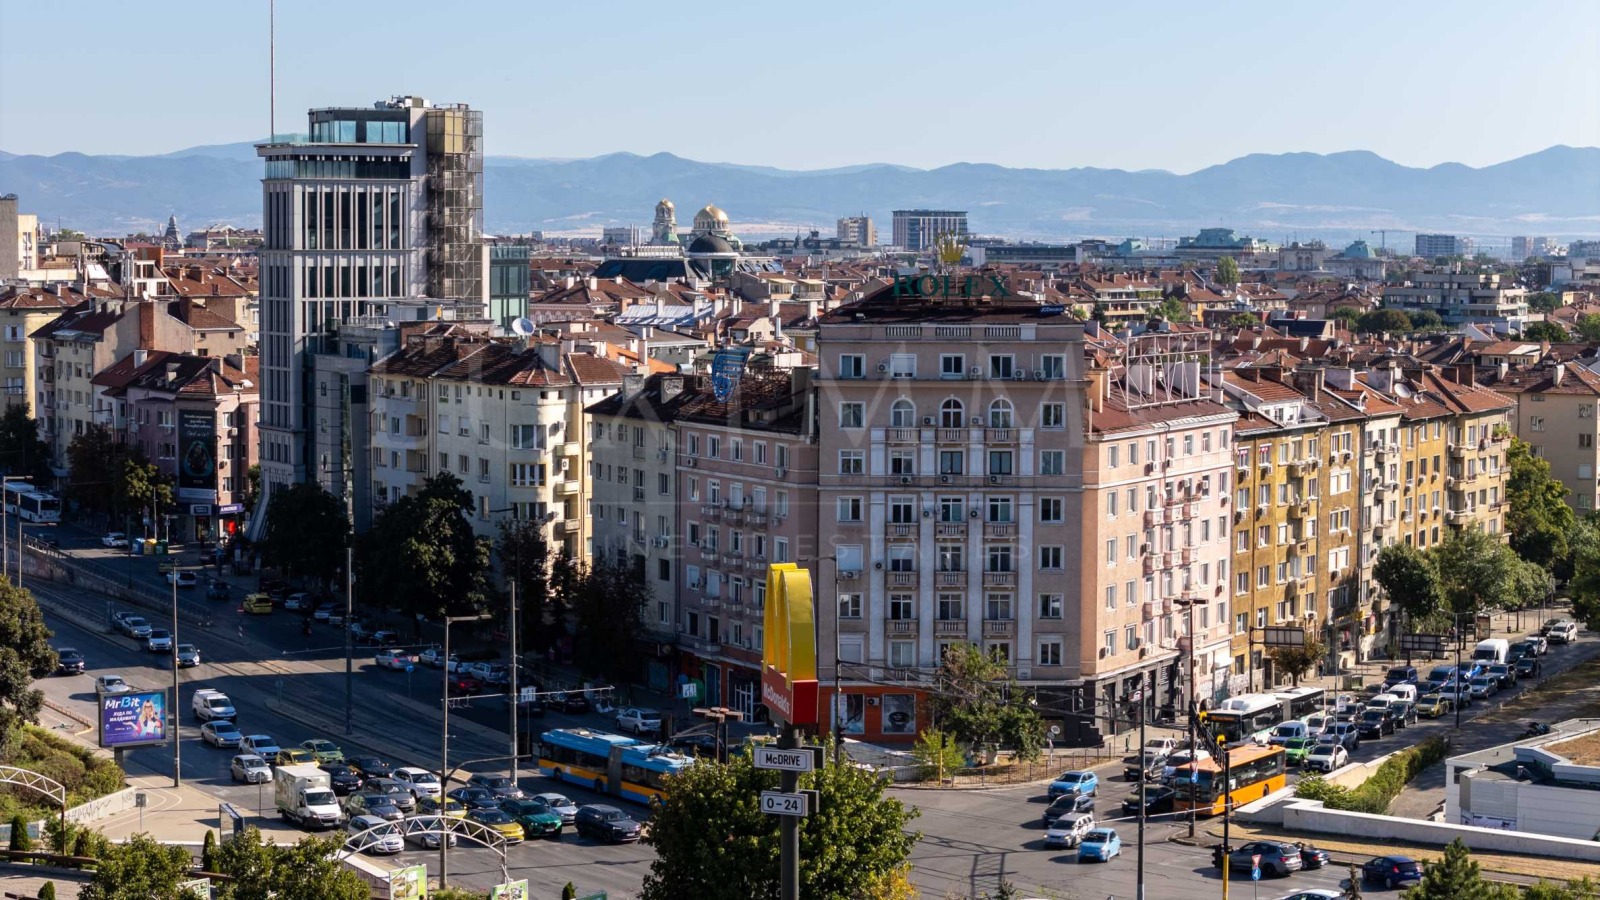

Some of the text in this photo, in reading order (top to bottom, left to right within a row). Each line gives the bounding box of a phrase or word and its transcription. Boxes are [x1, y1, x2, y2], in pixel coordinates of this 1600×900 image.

[892, 271, 1011, 297] ROLEX
[105, 697, 140, 709] MrBit
[763, 683, 790, 715] McDonald's
[765, 753, 801, 767] McDRIVE
